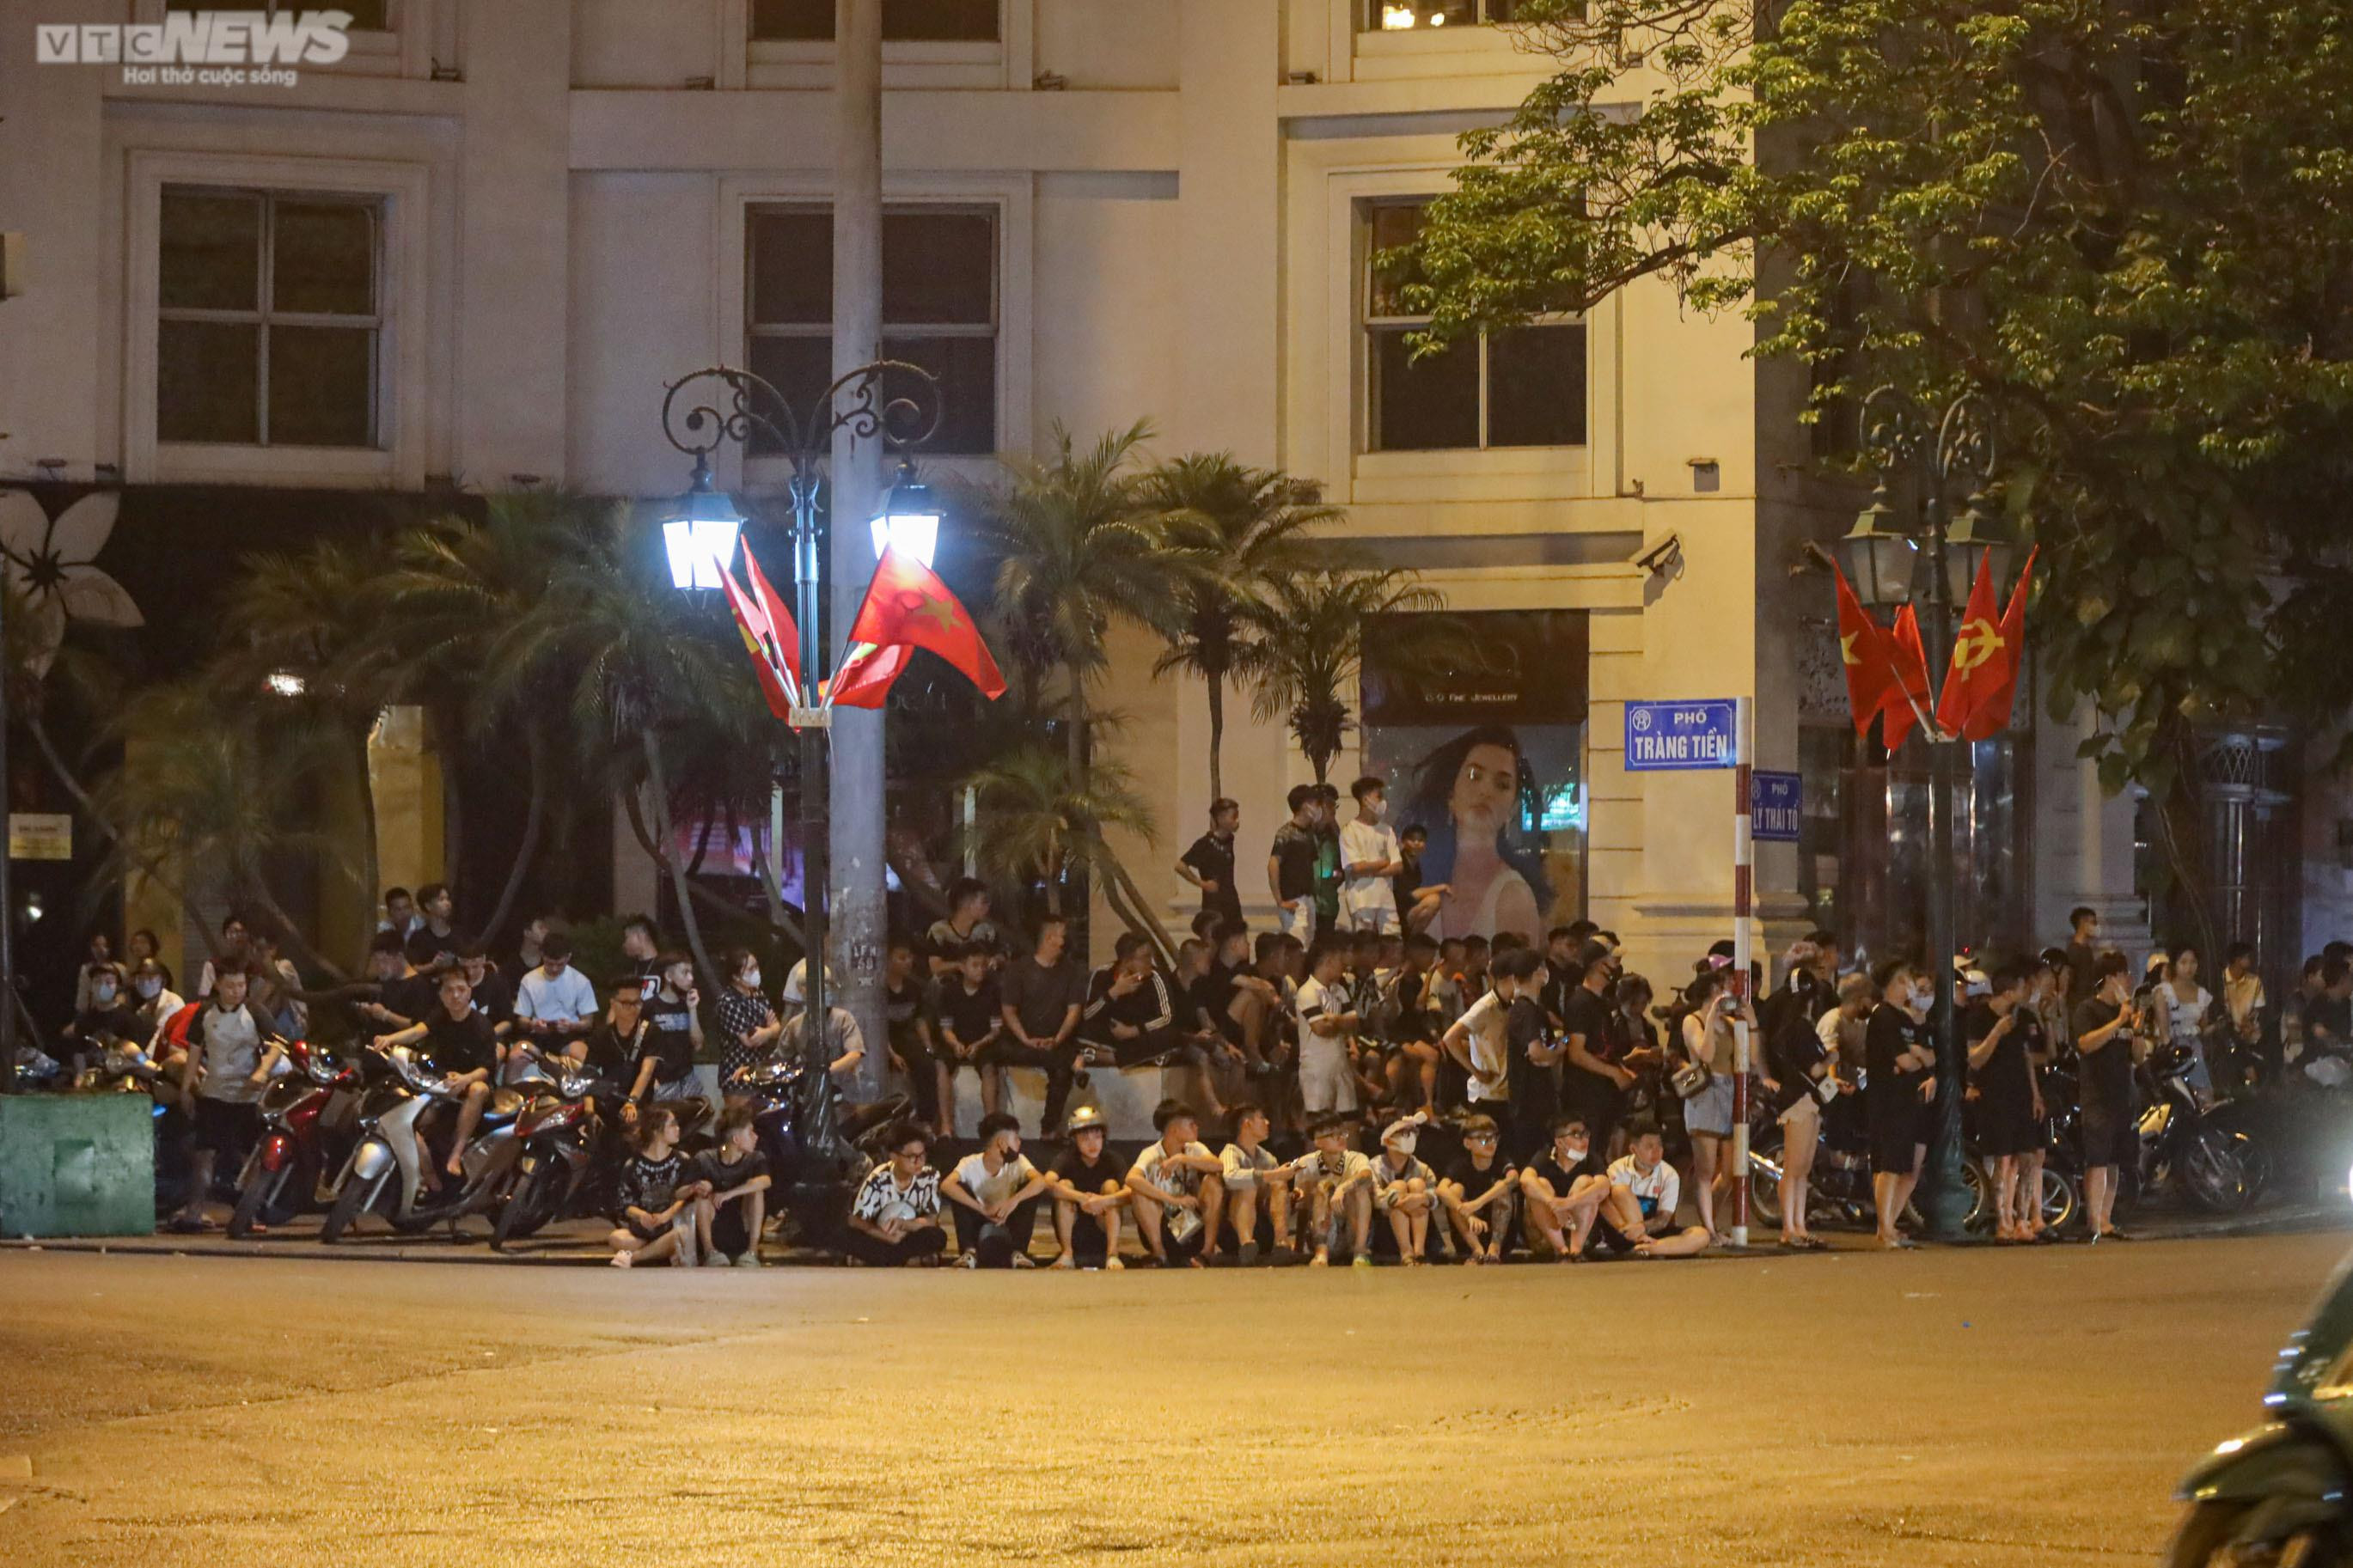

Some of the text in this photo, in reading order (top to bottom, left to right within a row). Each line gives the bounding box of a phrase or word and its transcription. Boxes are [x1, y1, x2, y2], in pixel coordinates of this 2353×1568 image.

[1674, 706, 1708, 724] PHỐ
[1635, 727, 1727, 760] TRÀNG TIỀN
[1753, 802, 1763, 830] LÝ
[1765, 802, 1786, 831] THÁI
